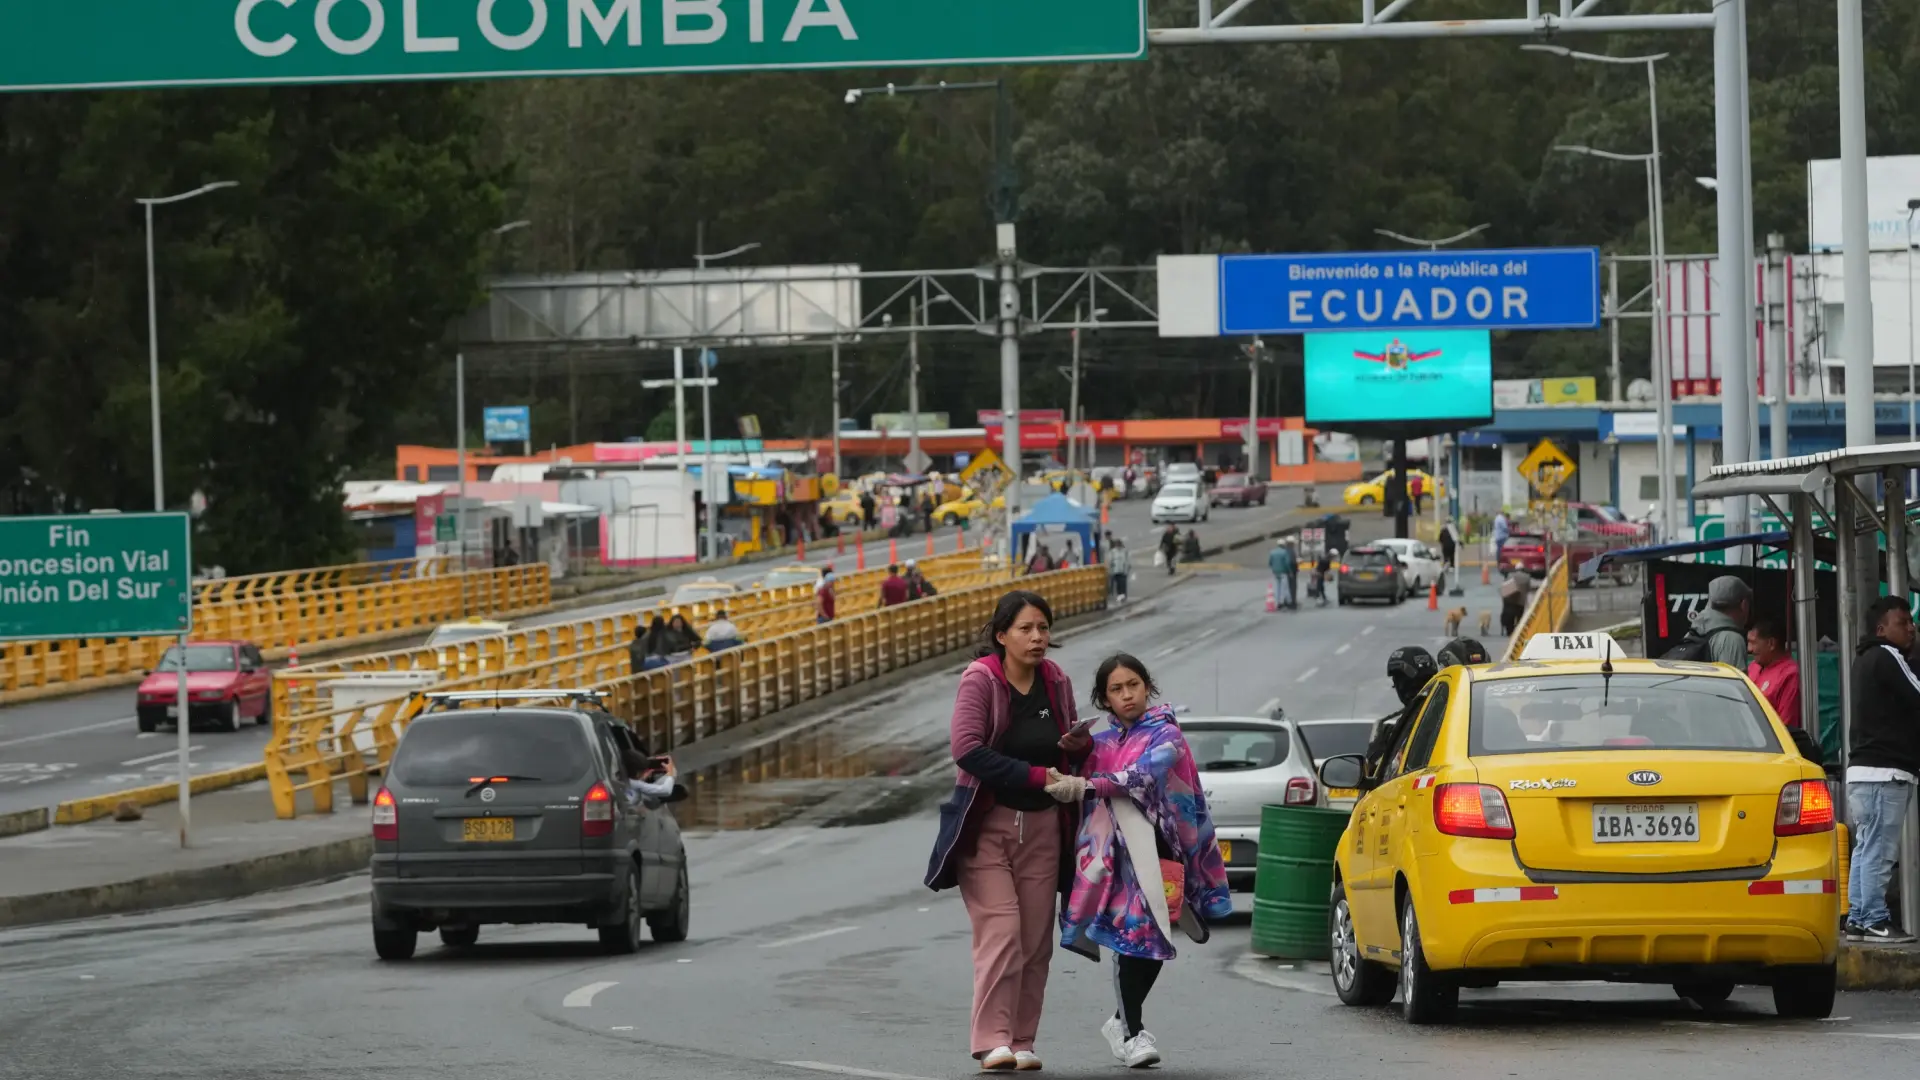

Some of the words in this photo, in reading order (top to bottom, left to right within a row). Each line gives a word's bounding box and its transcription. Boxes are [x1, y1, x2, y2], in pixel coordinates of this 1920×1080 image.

[234, 0, 859, 57] COLOMBIA
[1288, 263, 1379, 281] Bienvenido
[1383, 266, 1394, 278] a
[1398, 262, 1414, 278] la
[1503, 259, 1528, 277] del
[1288, 285, 1529, 323] ECUADOR
[49, 524, 90, 548] Fin
[121, 549, 169, 573] Vial
[67, 578, 109, 601] Del
[116, 576, 161, 600] Sur
[1550, 635, 1594, 650] TAXI
[1632, 771, 1658, 783] KIA
[1625, 804, 1665, 814] ECUADOR
[1596, 815, 1696, 838] IBA-3696
